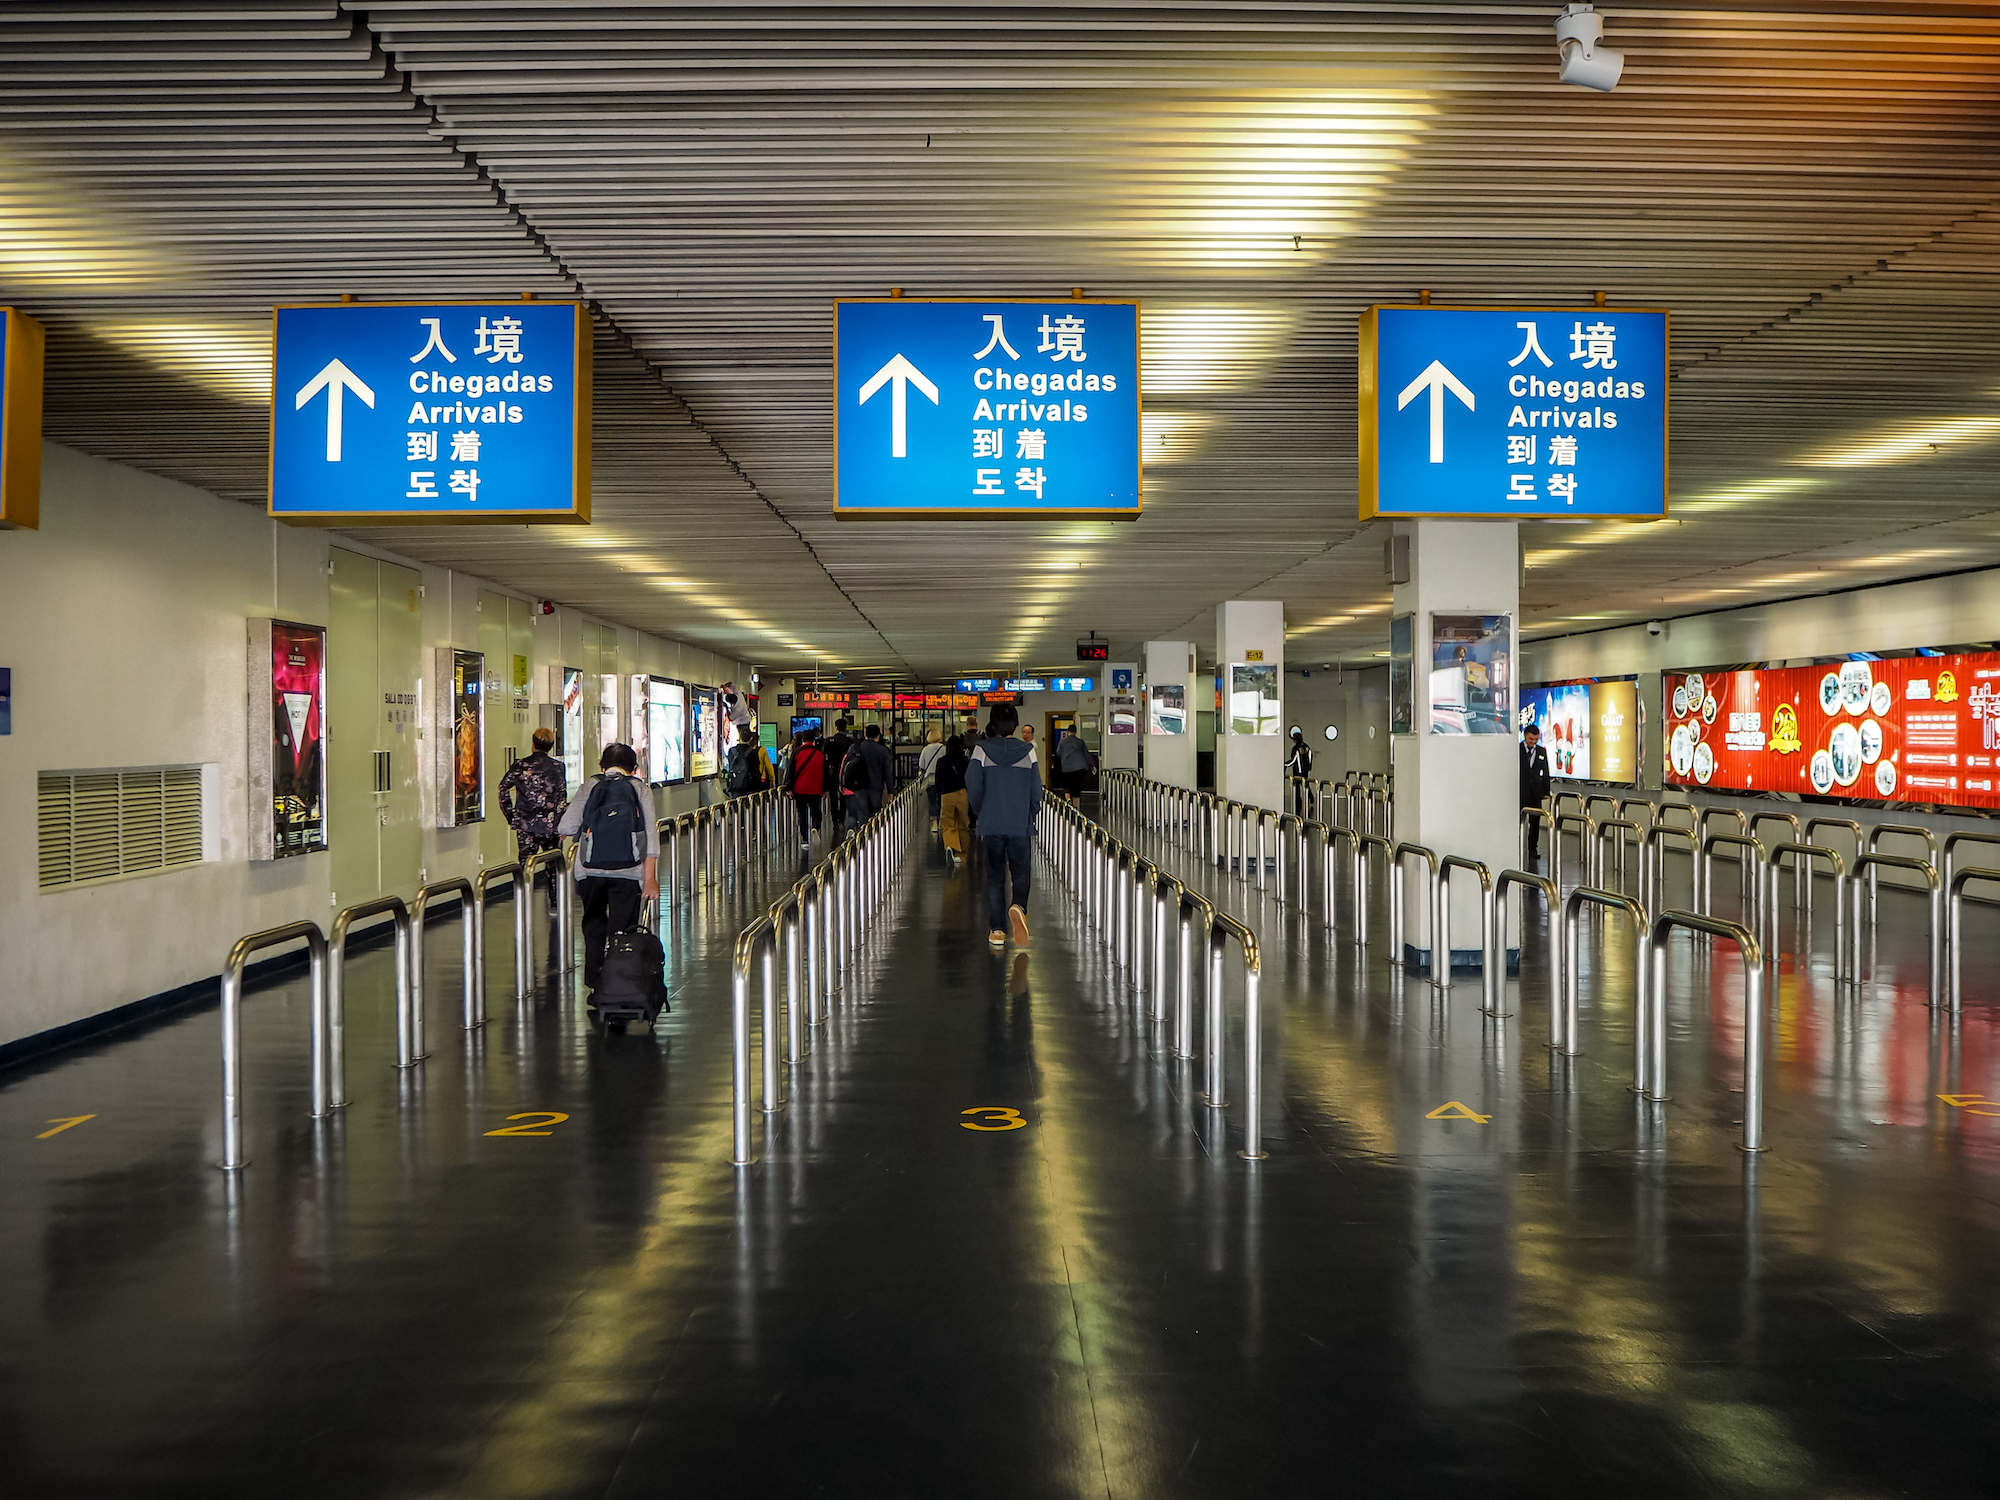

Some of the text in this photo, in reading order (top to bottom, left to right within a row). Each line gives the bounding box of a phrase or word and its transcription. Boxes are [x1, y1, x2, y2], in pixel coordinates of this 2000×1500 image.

[409, 370, 554, 399] Chegadas
[973, 367, 1117, 397] Chegadas
[1508, 374, 1646, 404] Chegadas
[407, 400, 524, 424] Arrivals
[972, 398, 1088, 422] Arrivals
[1507, 405, 1618, 429] Arrivals
[1601, 713, 1624, 727] GALAXY
[1425, 1101, 1493, 1124] 4
[1935, 1094, 2000, 1117] 5
[35, 1113, 98, 1139] 1
[482, 1111, 569, 1136] 2
[960, 1106, 1027, 1131] 3
